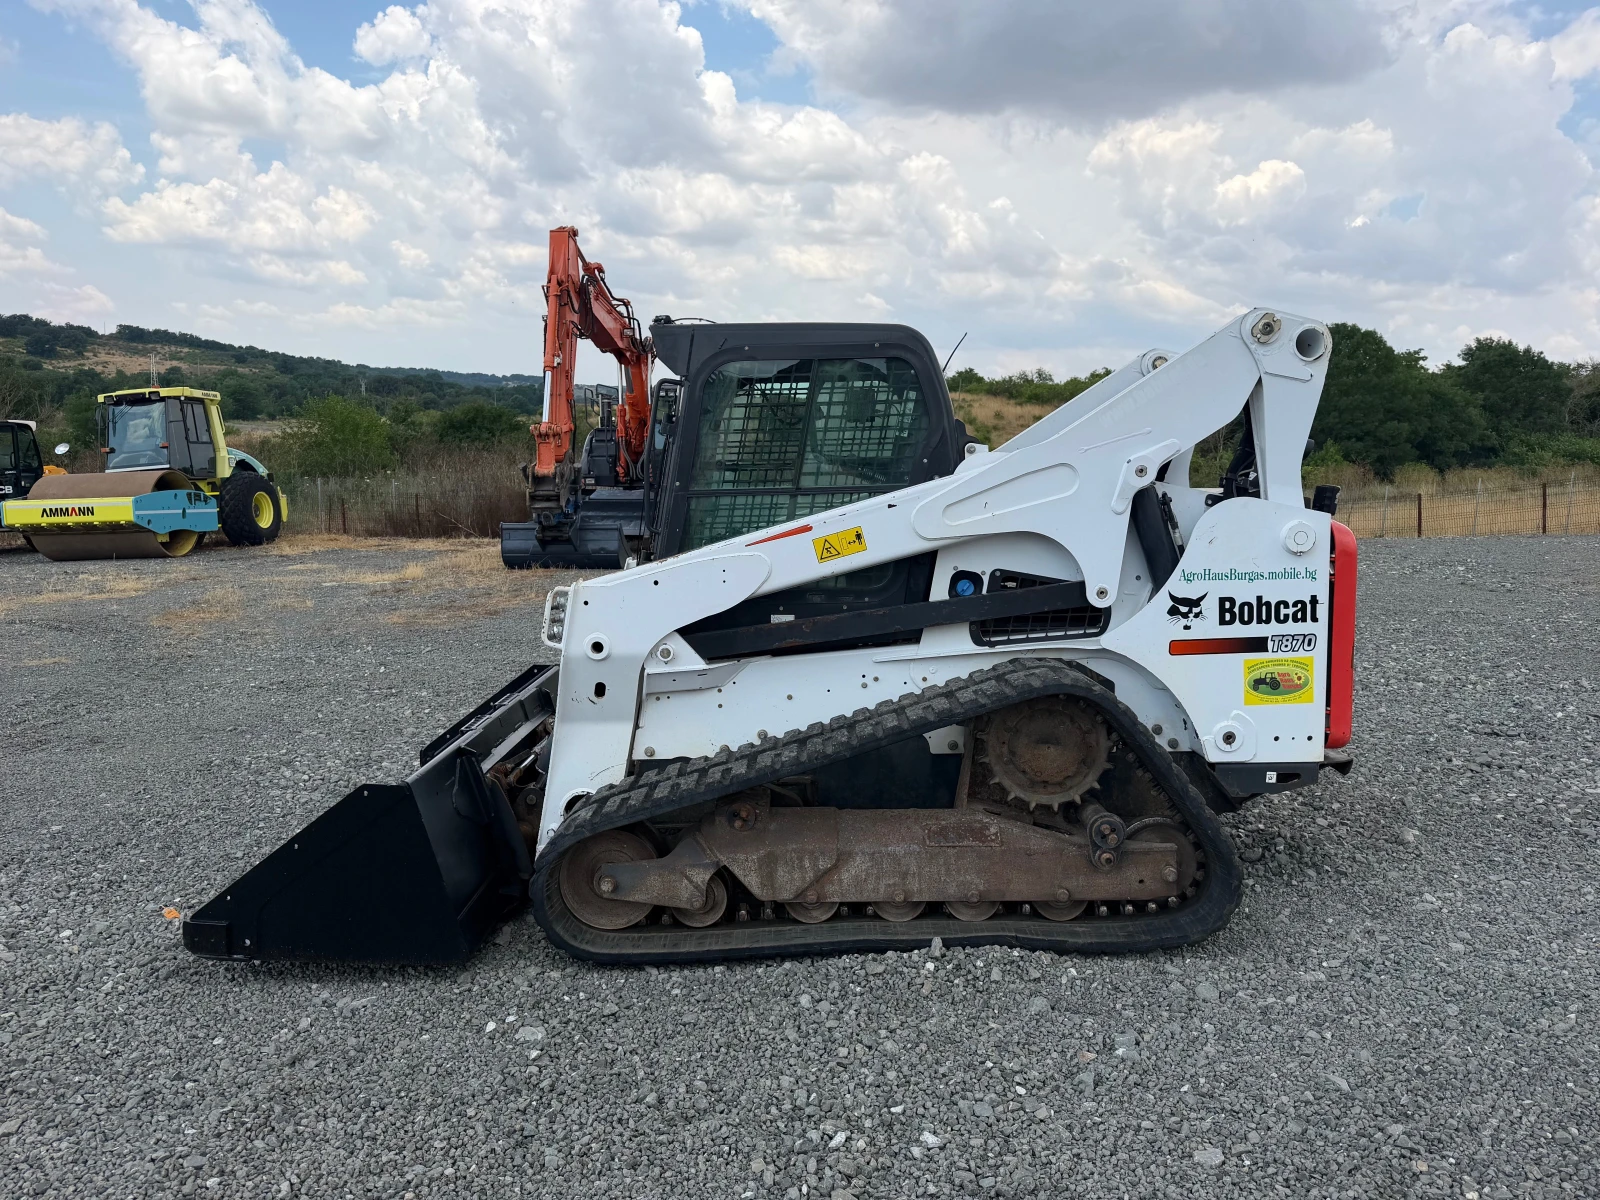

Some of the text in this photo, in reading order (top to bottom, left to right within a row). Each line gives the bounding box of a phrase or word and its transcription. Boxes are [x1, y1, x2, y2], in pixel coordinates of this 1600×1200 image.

[0, 485, 13, 494] CB
[41, 506, 95, 518] AMMANN
[1179, 568, 1317, 583] AgroHausBurgas.mobile.bg
[1218, 595, 1319, 626] Bobcat
[1270, 633, 1317, 652] T870
